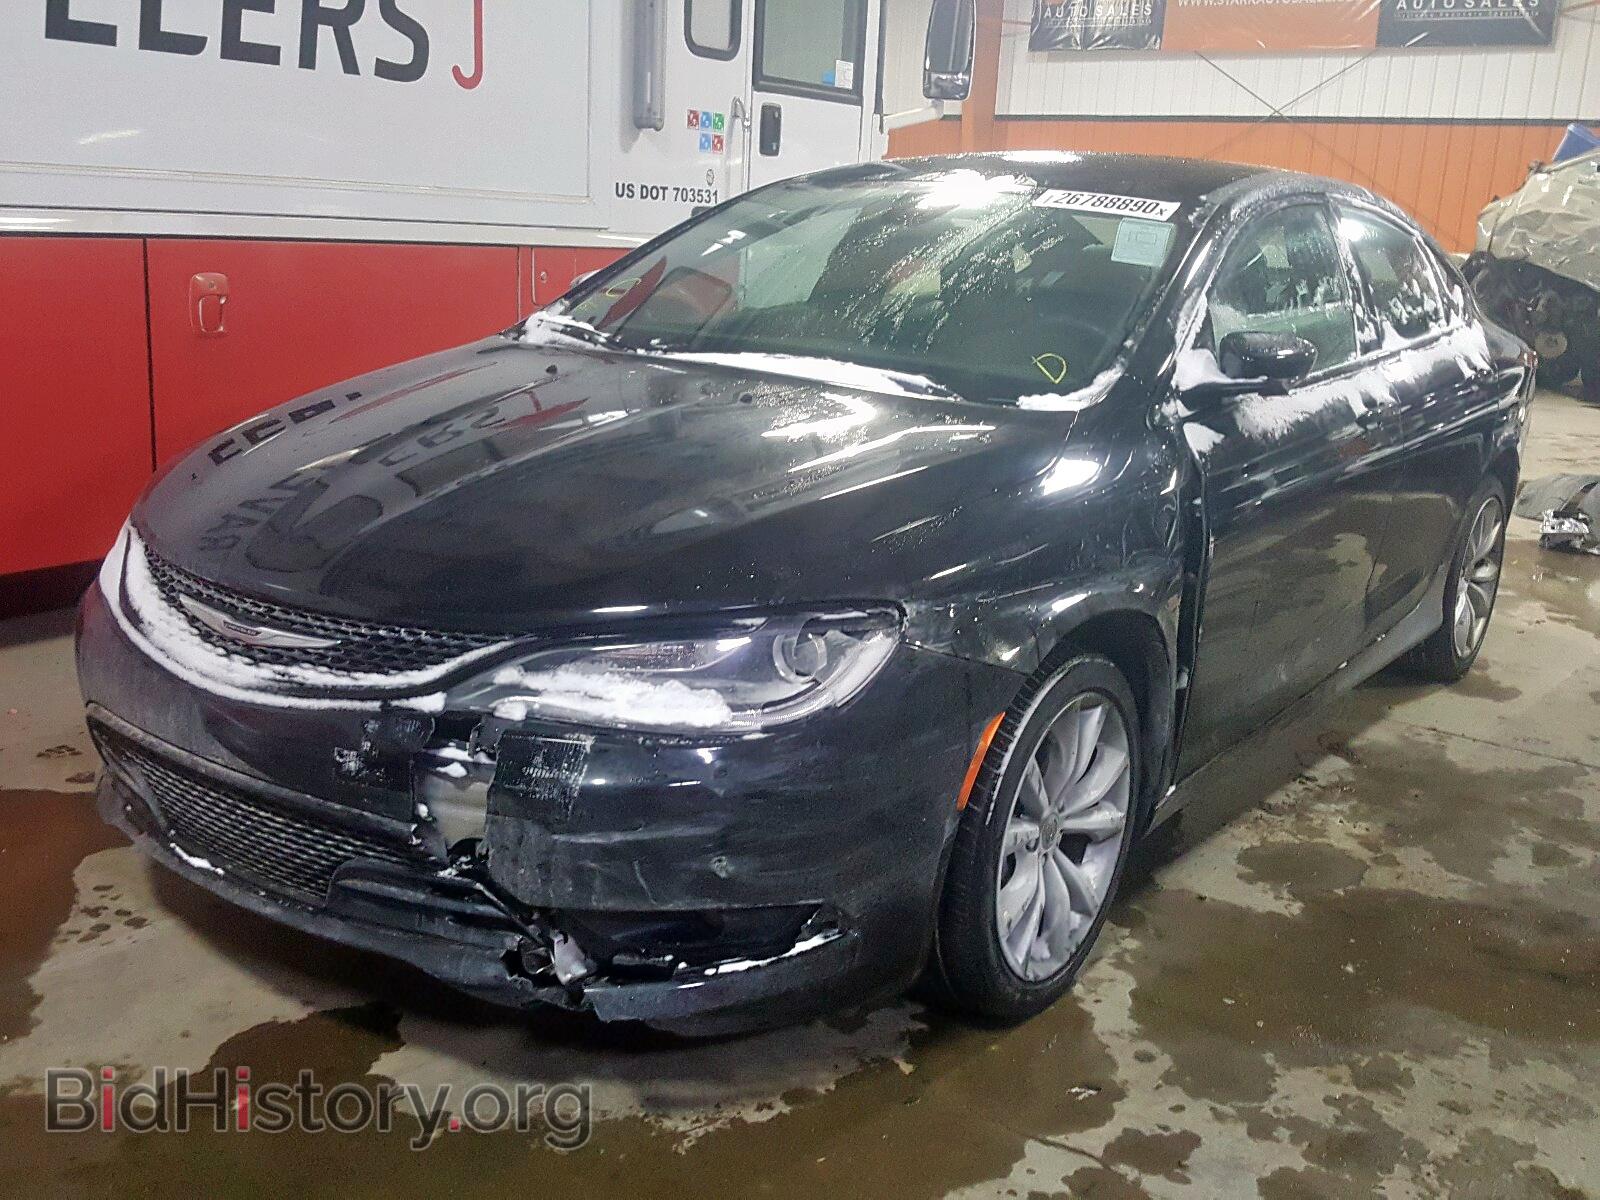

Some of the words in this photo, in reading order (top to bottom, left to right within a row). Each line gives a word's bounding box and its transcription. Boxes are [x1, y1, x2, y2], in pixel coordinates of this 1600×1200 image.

[1043, 5, 1089, 18] AUTO
[1095, 4, 1152, 16] SALES
[615, 182, 635, 199] US
[640, 184, 668, 200] DOT
[672, 187, 719, 204] 703531
